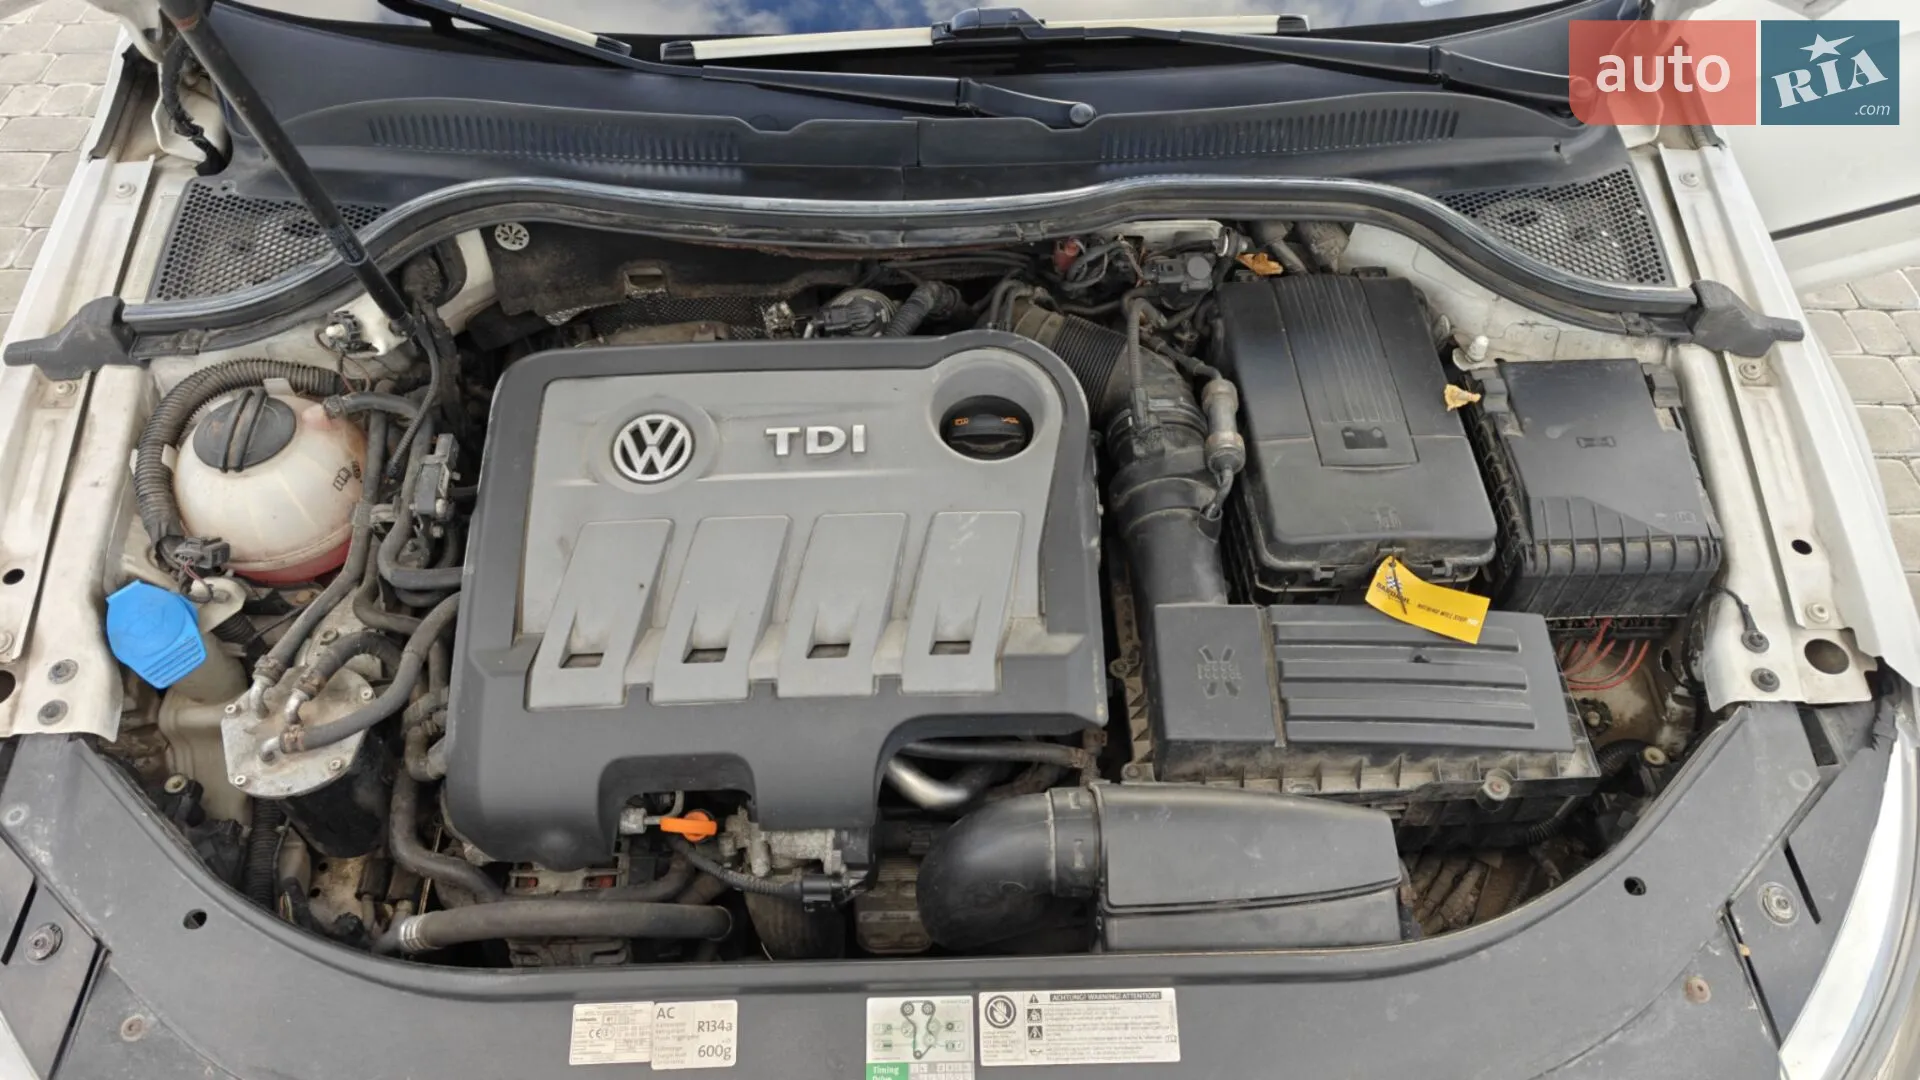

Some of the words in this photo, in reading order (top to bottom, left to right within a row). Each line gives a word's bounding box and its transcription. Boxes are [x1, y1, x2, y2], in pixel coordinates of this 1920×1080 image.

[765, 424, 866, 456] TDI
[656, 1006, 676, 1020] AC
[697, 1020, 733, 1033] R134a
[697, 1044, 732, 1061] 600g
[872, 1065, 900, 1076] Timing
